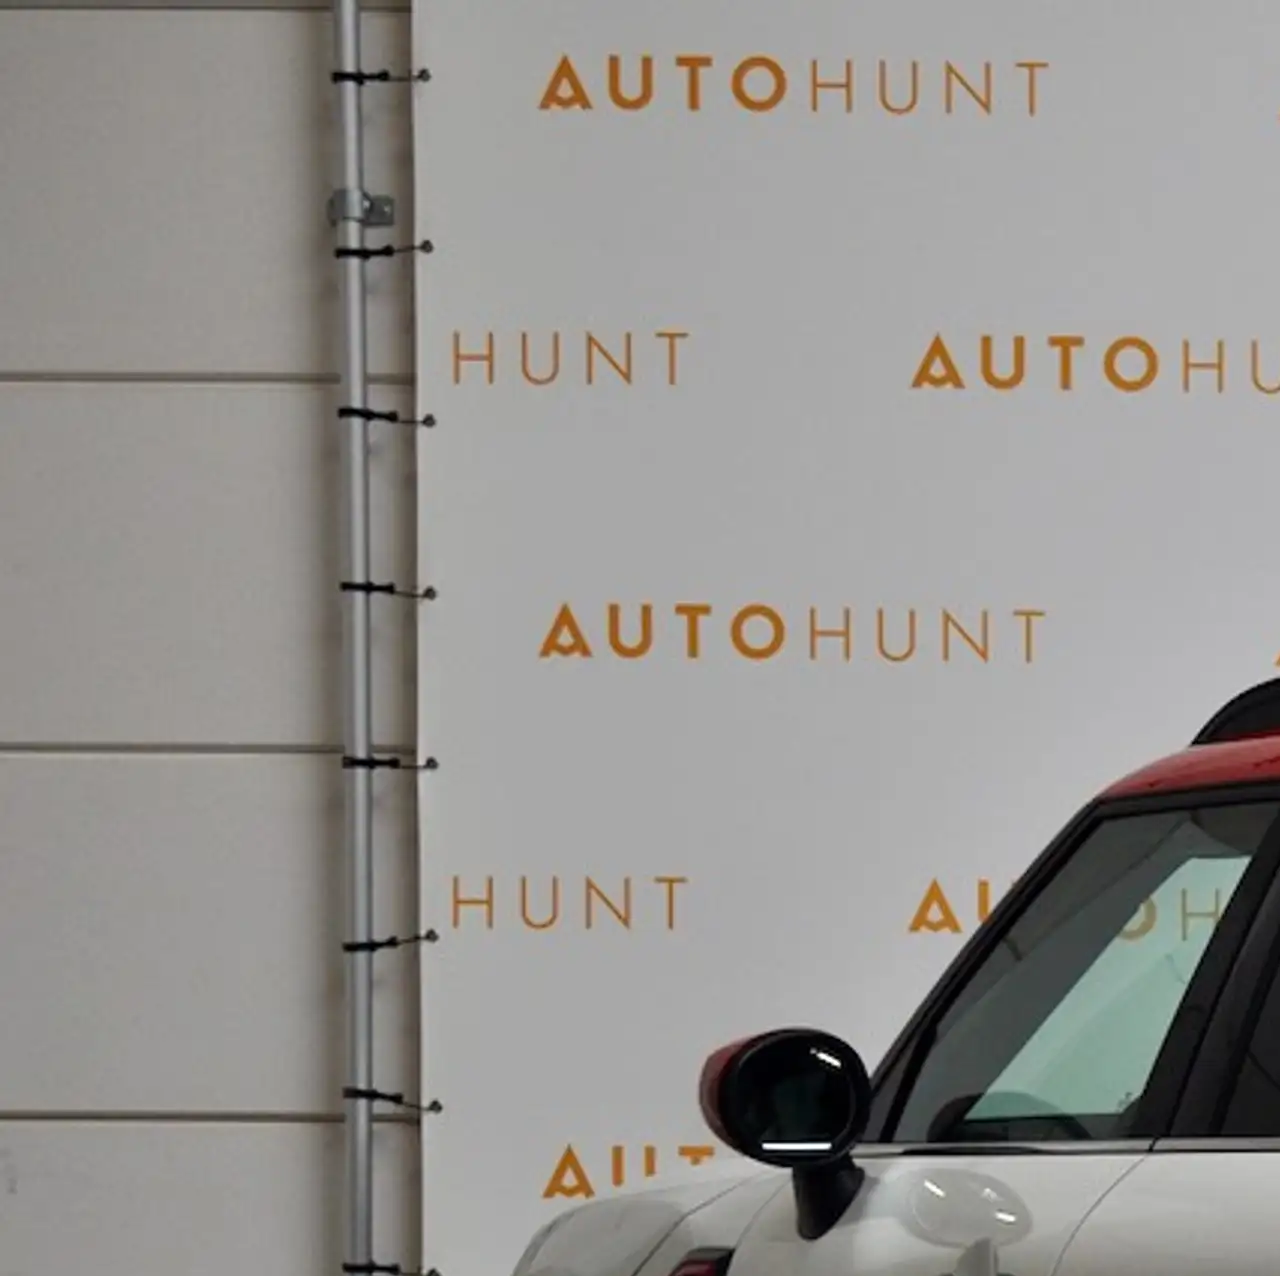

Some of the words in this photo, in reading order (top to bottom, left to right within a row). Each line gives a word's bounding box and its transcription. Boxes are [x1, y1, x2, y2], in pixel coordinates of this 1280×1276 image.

[539, 52, 1050, 115] AUTOHUNT
[452, 329, 689, 385] HUNT
[539, 601, 1047, 662] AUTOHUNT
[452, 877, 690, 930] HUNT
